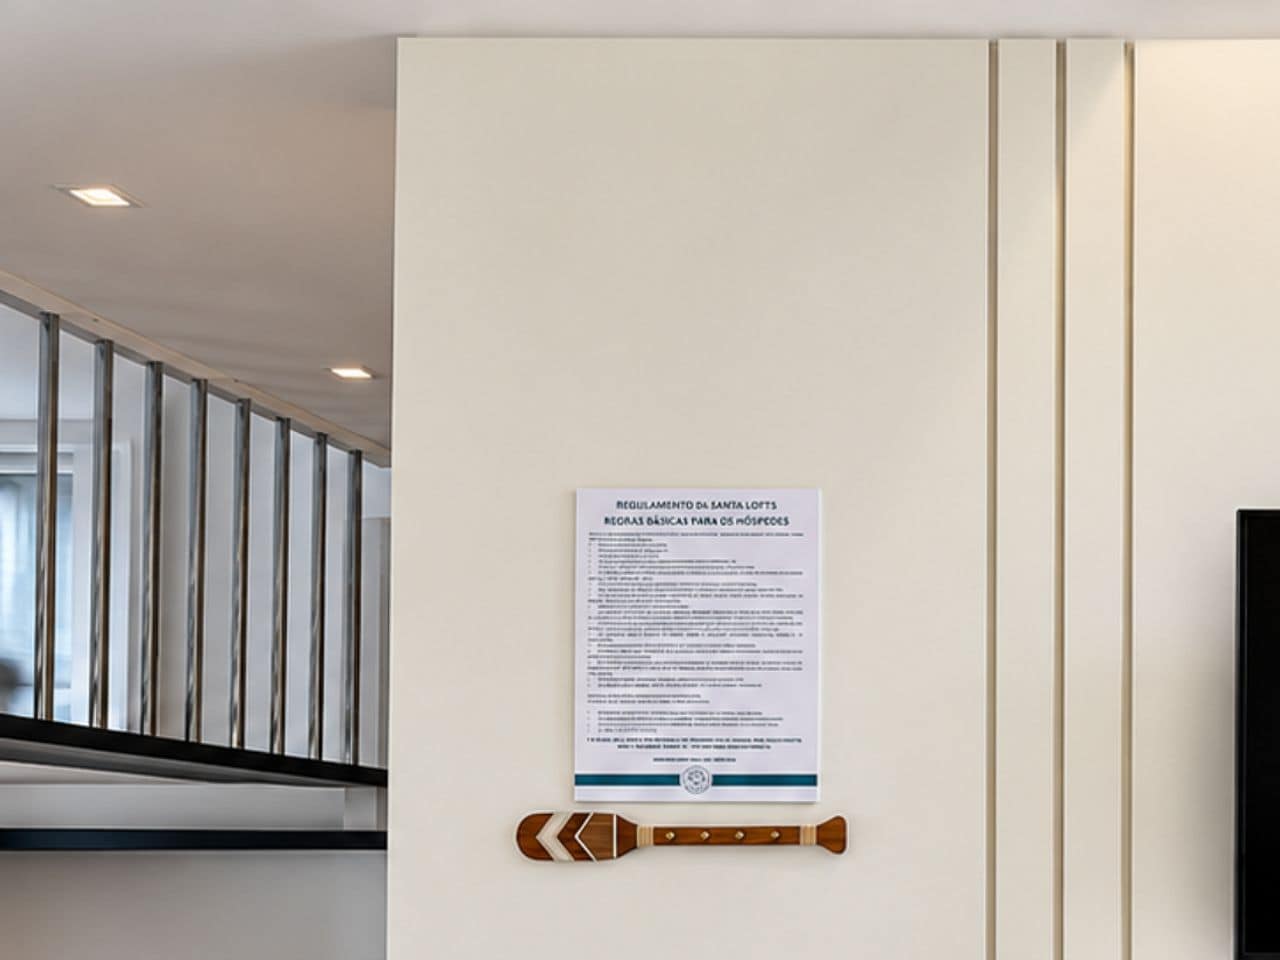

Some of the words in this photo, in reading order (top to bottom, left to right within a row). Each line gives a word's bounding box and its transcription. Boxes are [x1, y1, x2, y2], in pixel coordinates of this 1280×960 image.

[616, 500, 694, 510] REGULAMENTO
[711, 500, 744, 510] SANTA
[746, 500, 778, 510] LOFTS
[691, 516, 718, 526] PARA
[720, 516, 733, 526] OS
